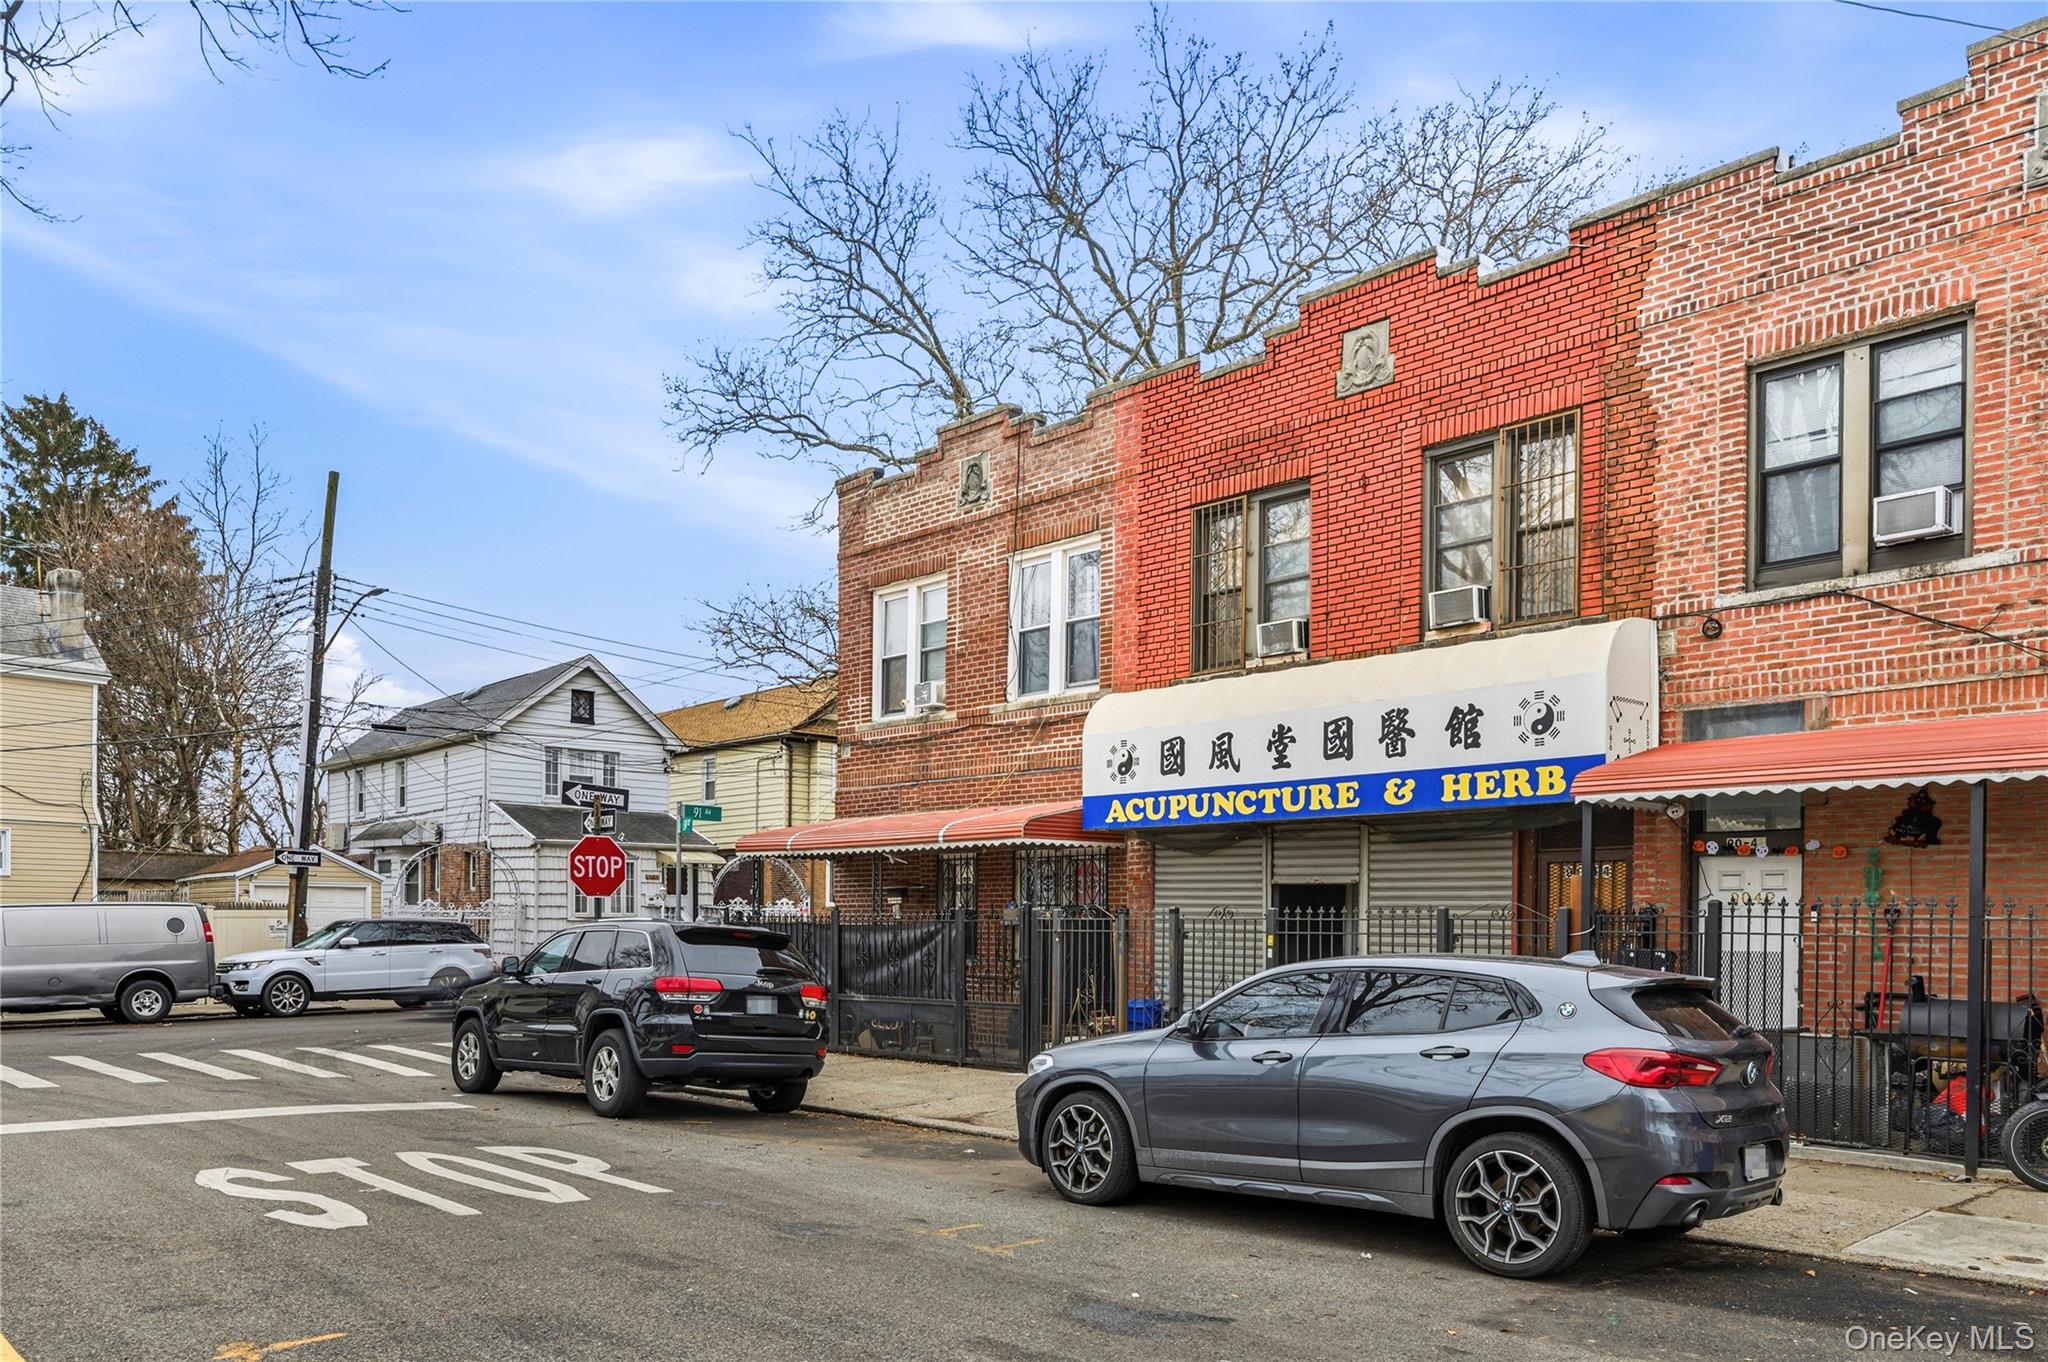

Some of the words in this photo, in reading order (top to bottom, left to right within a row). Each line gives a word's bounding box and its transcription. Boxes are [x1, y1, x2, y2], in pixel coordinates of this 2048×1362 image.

[1159, 703, 1485, 777] 國風堂國醫館
[574, 789, 595, 800] ONE
[1105, 781, 1361, 824] ACUPUNCTURE
[1383, 777, 1416, 806] &
[1440, 764, 1567, 803] HERB
[693, 806, 702, 819] 91
[573, 855, 623, 878] STOP
[1715, 1114, 1733, 1124] X2
[195, 1146, 674, 1230] STOP
